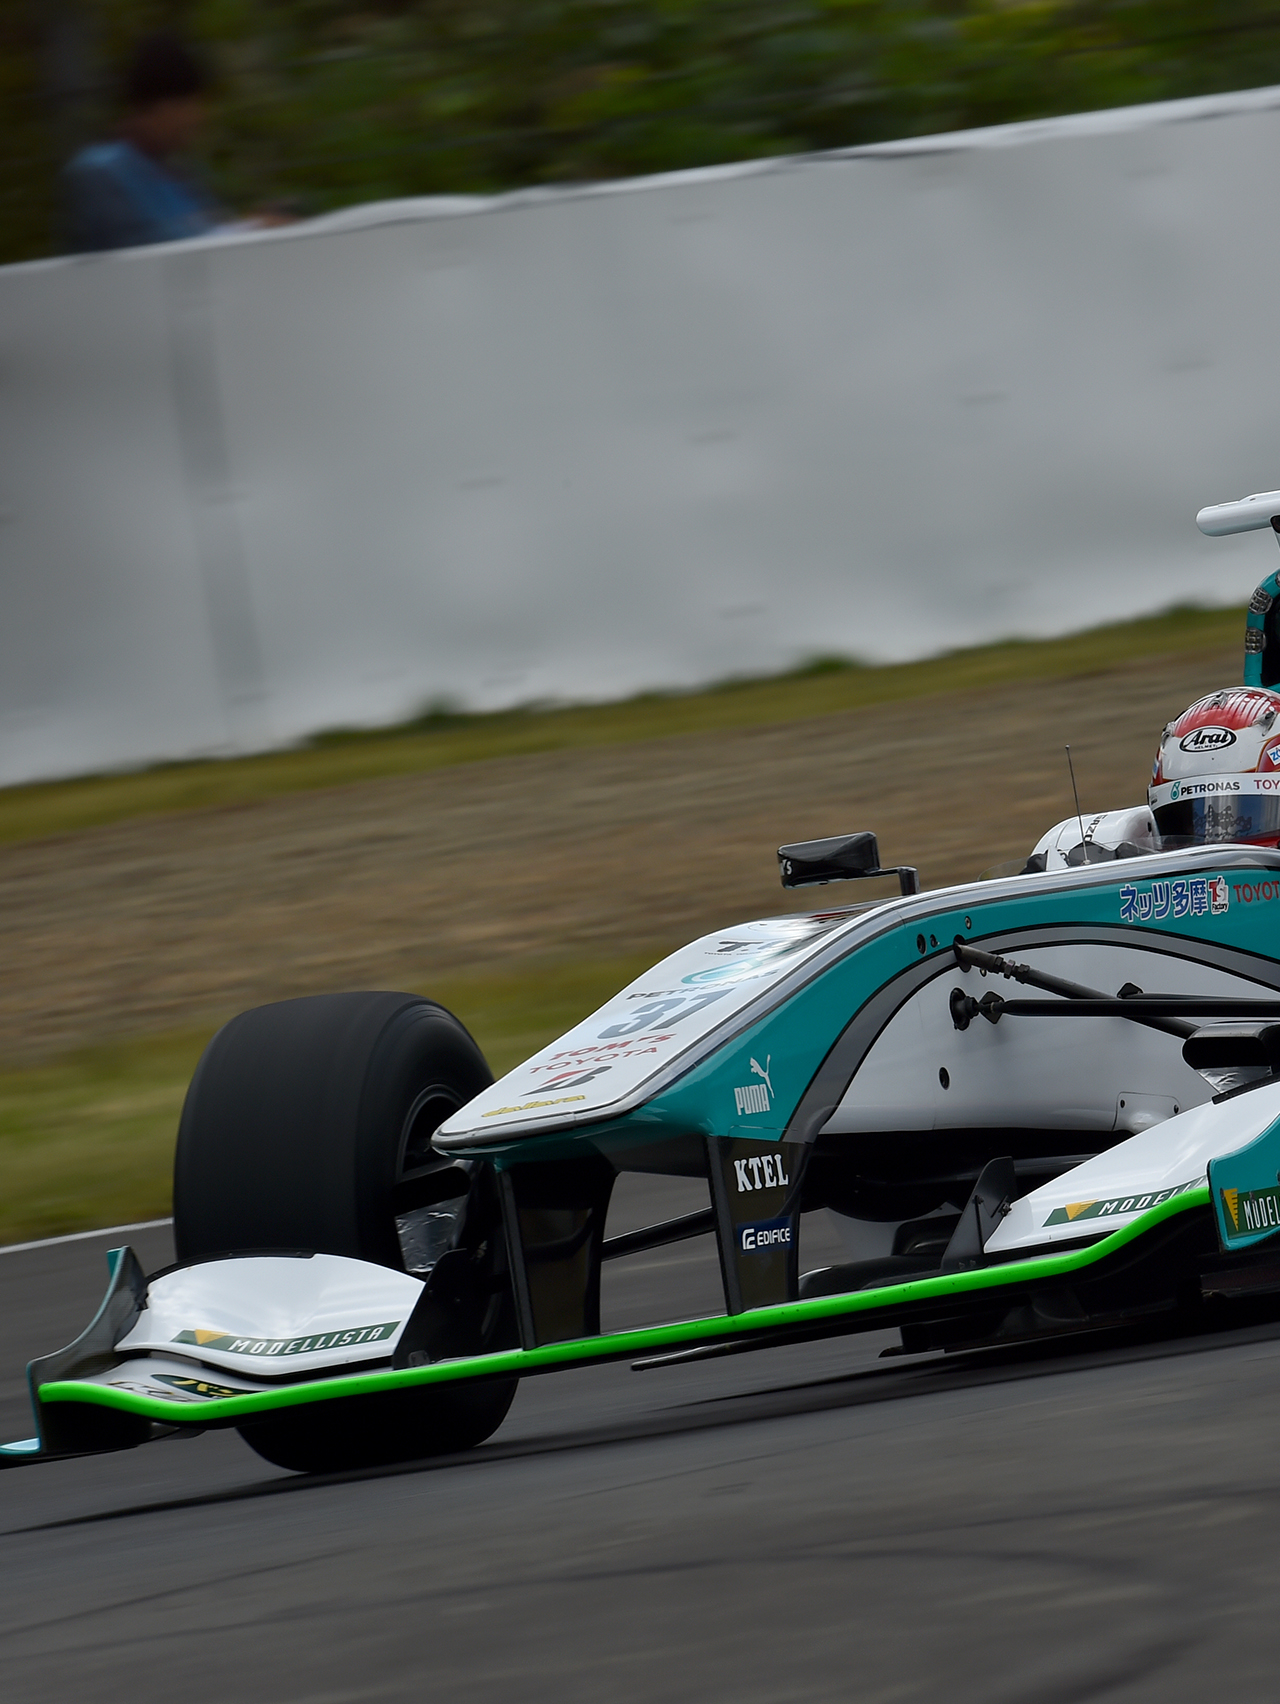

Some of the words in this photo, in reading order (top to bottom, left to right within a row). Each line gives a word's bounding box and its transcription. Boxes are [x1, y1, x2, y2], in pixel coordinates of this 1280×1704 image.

[1188, 730, 1232, 745] Arai
[1180, 781, 1241, 796] PETRONAS
[1120, 879, 1209, 922] ネッツ多摩
[626, 968, 780, 1000] PETRONAS
[596, 987, 737, 1040] 37
[530, 1046, 658, 1075] TOYOTA
[549, 1033, 677, 1061] TOM'S
[734, 1083, 770, 1115] PUMA
[733, 1153, 789, 1193] KTEL
[757, 1227, 791, 1246] EDIFICE
[227, 1326, 386, 1356] MODELLISTA
